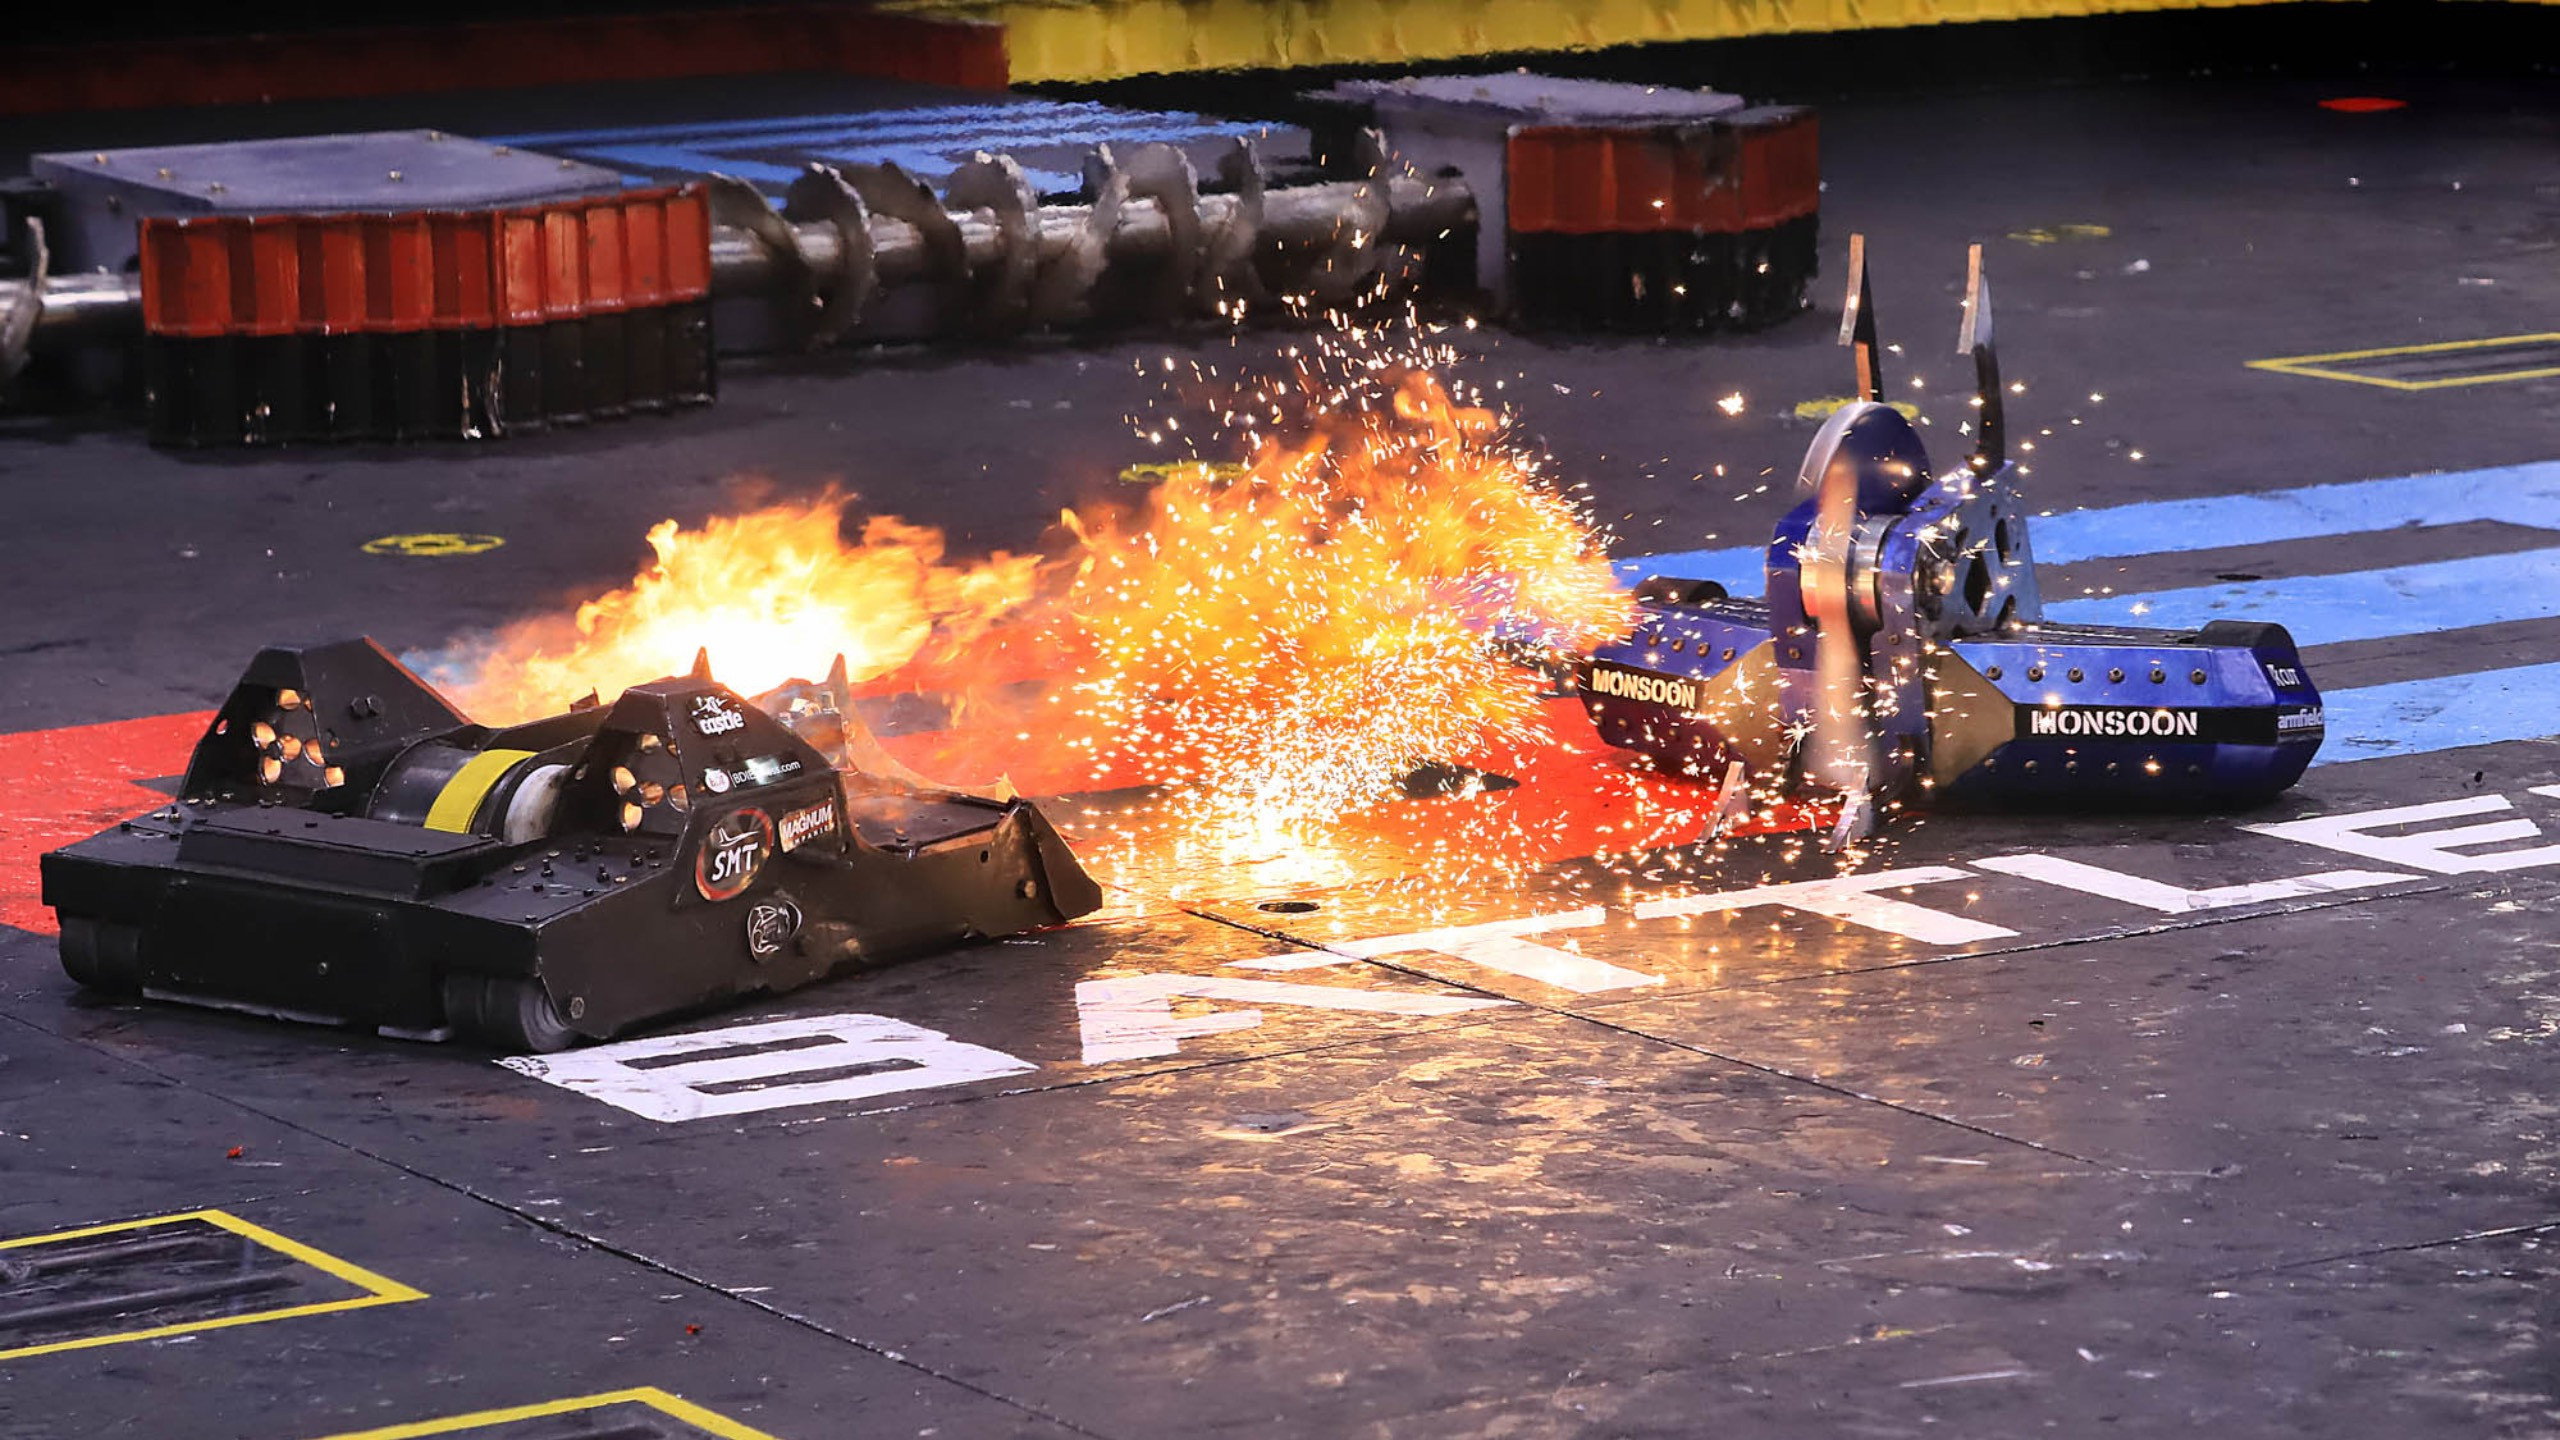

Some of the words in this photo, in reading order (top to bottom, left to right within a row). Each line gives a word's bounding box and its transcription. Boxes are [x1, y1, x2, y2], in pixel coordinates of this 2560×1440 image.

[1592, 667, 1696, 709] MONSOON
[699, 709, 745, 735] castle
[2031, 710, 2198, 736] MONSOON
[782, 804, 833, 839] MAGNUM
[711, 842, 759, 882] SMT
[497, 784, 2560, 1123] BATTLE
